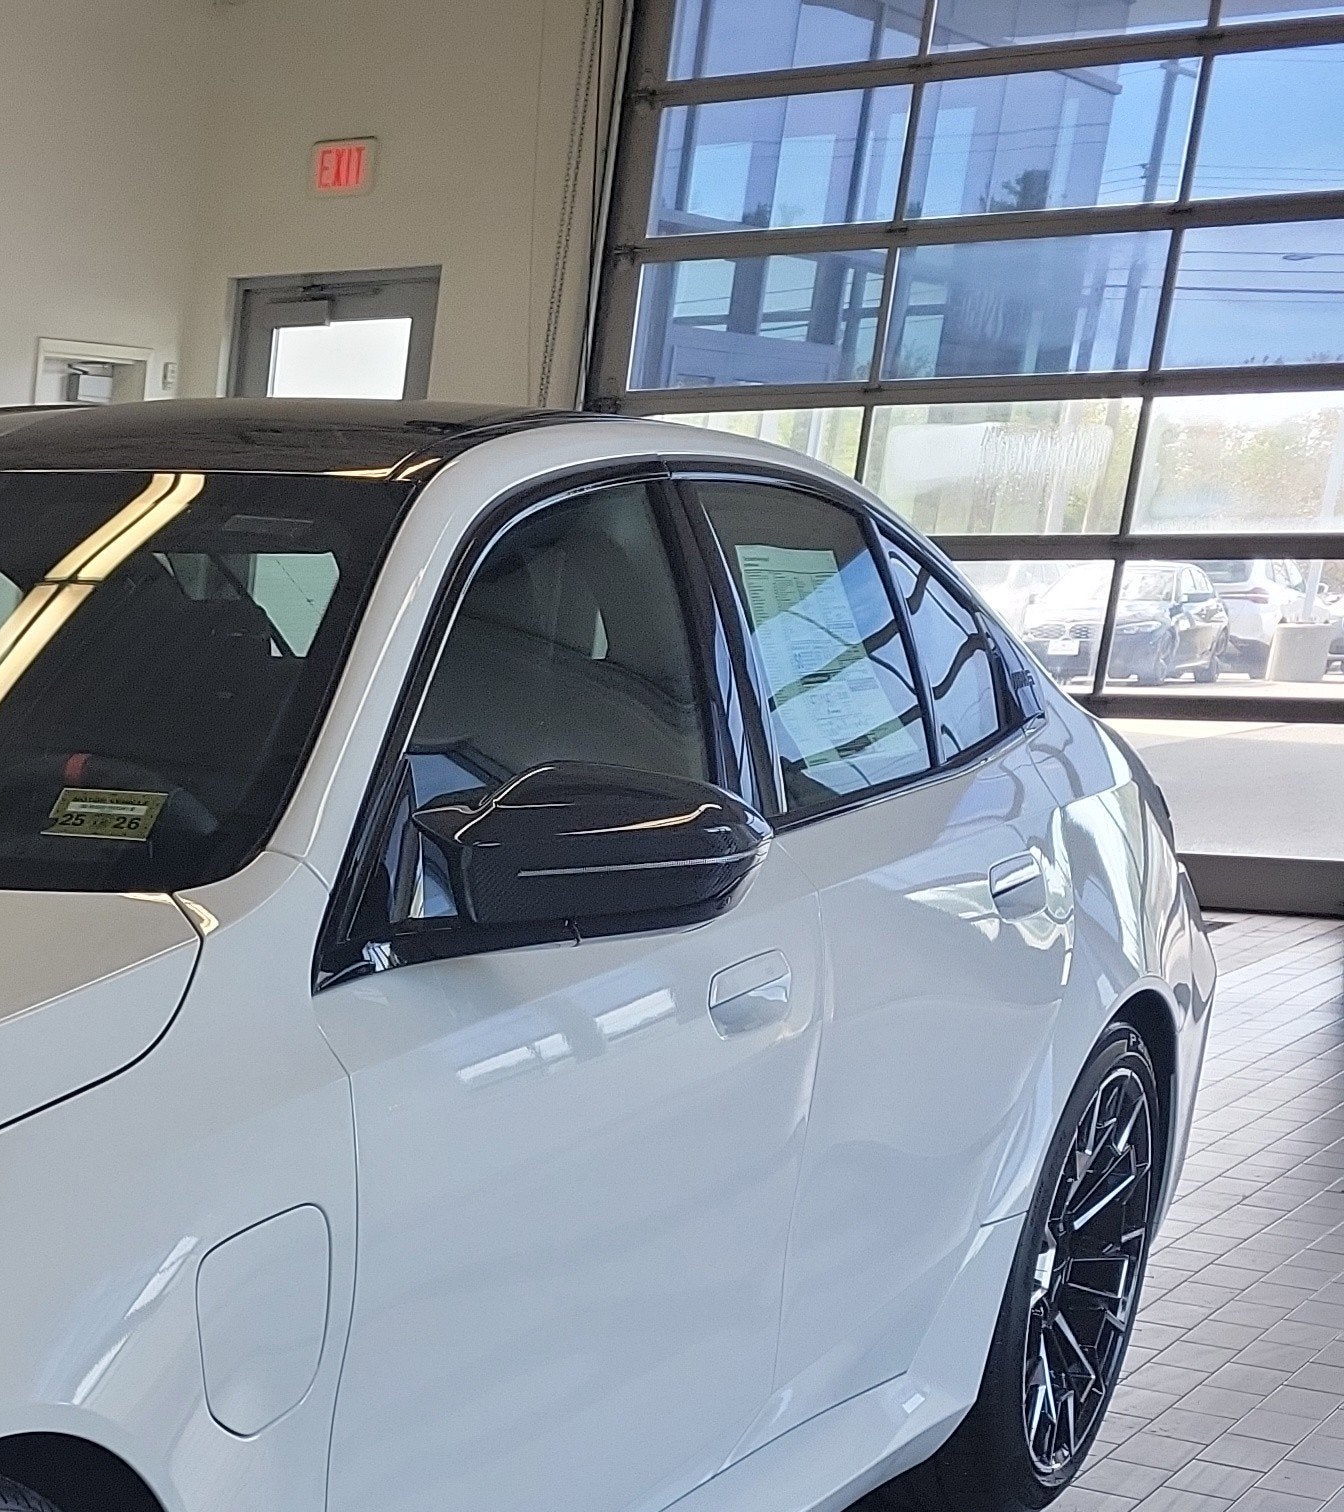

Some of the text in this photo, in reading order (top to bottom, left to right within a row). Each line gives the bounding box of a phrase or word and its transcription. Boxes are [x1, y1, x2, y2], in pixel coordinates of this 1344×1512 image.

[317, 146, 366, 188] EXIT
[59, 813, 86, 826] 25
[113, 816, 141, 830] 26
